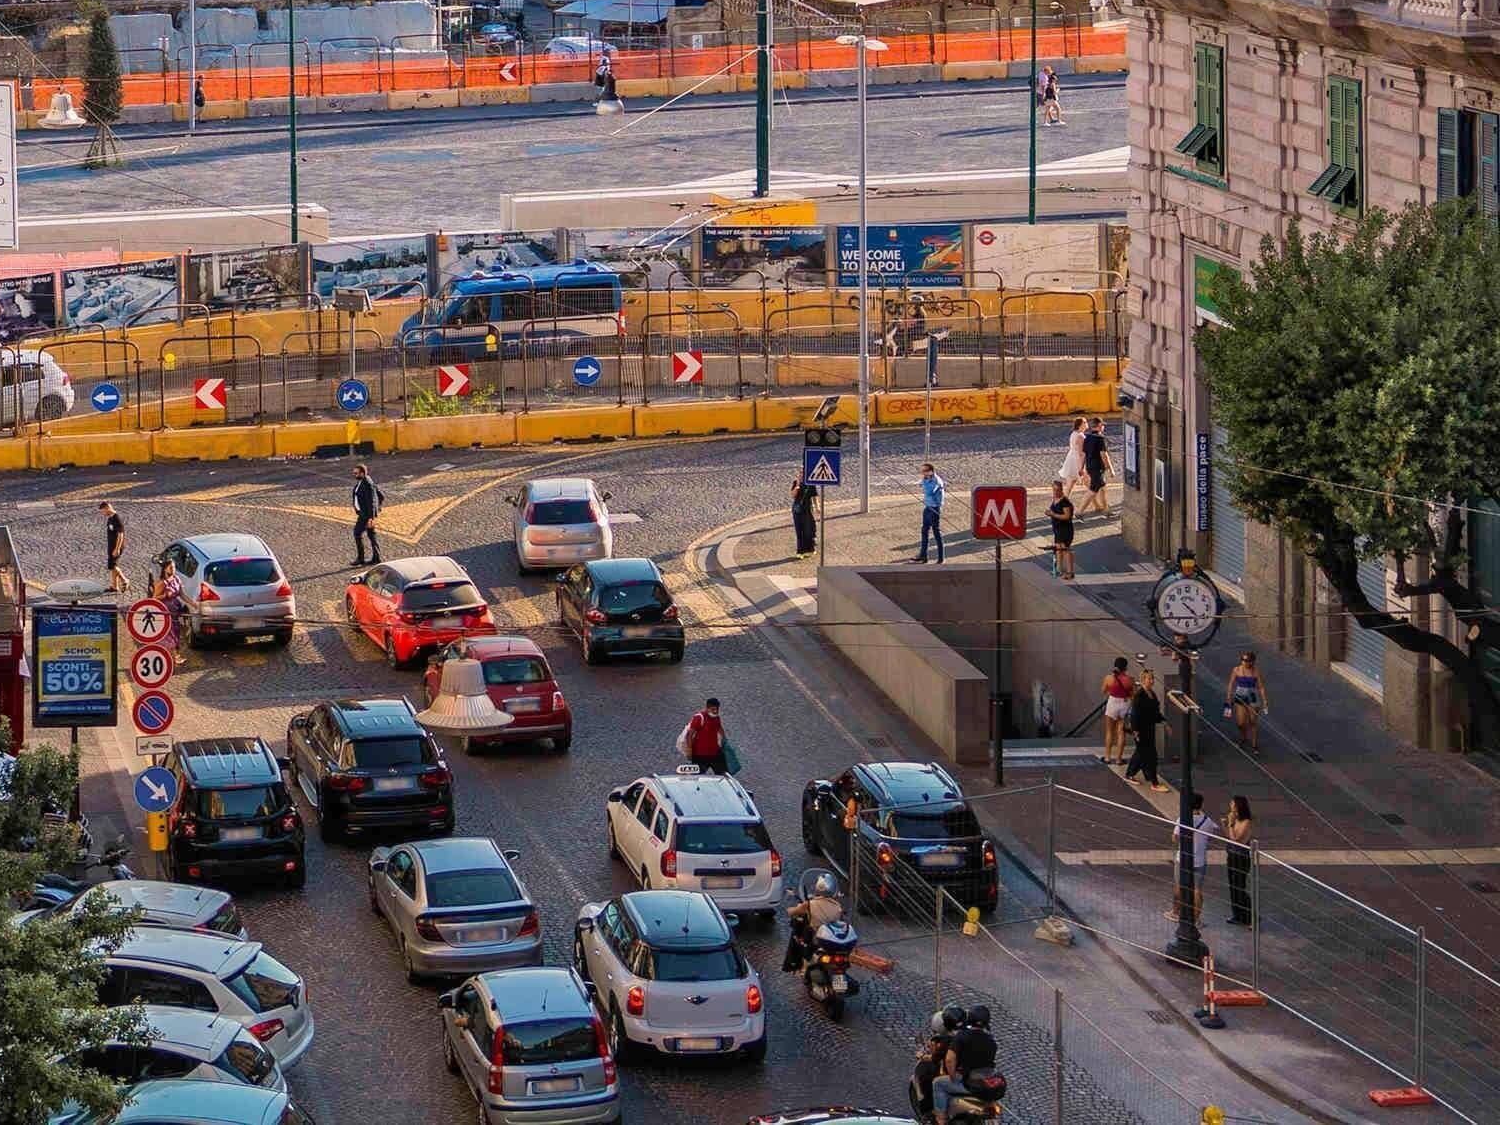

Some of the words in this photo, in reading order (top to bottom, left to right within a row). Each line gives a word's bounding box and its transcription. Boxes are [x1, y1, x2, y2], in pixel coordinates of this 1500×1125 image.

[841, 250, 901, 260] WECOME
[841, 261, 858, 271] TO
[1199, 435, 1209, 465] pace
[1198, 468, 1208, 495] della
[980, 498, 1020, 527] M
[1199, 496, 1209, 530] museo
[47, 662, 90, 672] SCONTI
[140, 656, 164, 677] 30
[47, 672, 102, 692] 50%
